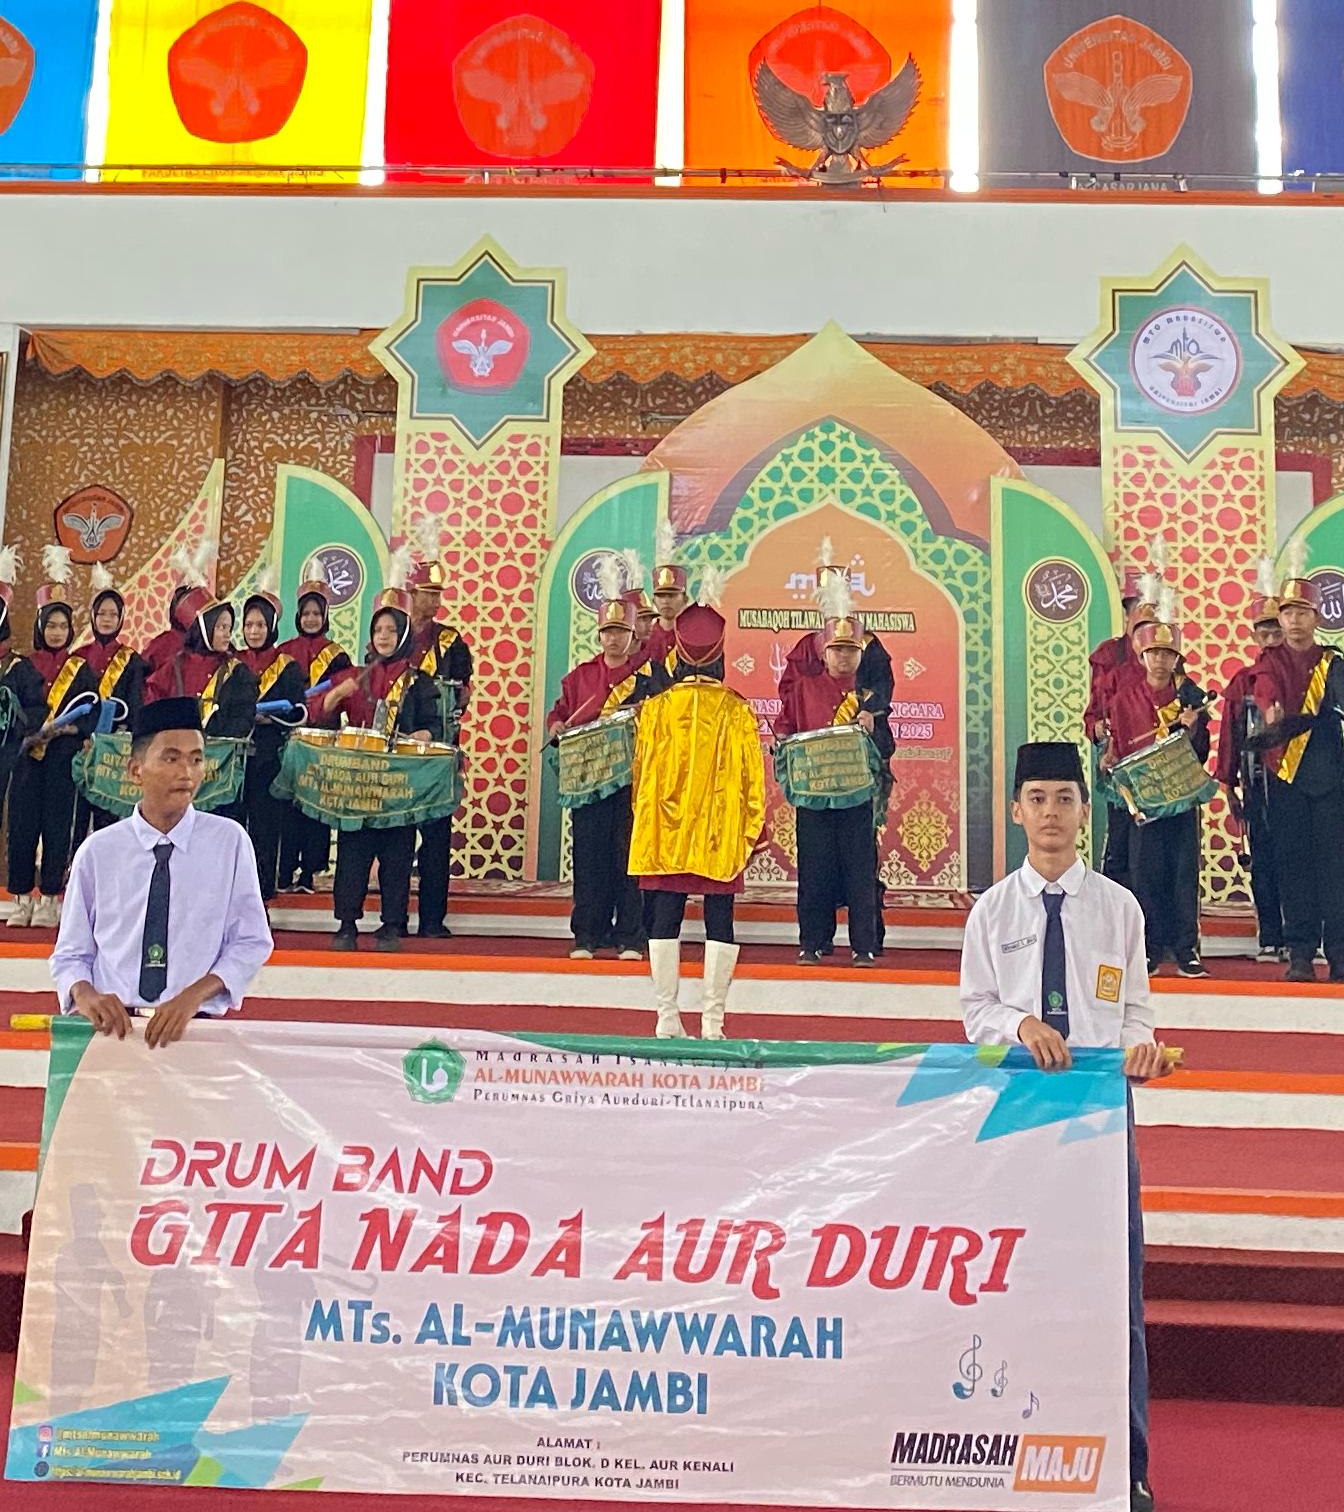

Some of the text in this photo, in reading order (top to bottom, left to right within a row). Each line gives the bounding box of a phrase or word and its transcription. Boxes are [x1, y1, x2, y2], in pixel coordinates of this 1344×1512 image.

[739, 610, 790, 631] MUSABAQOH
[866, 614, 915, 632] MAHASISWA
[900, 722, 932, 739] 2025
[319, 753, 391, 771] DRUMBAND
[473, 1067, 765, 1092] AL-MUNAWWARAH KOTA JAMBI
[139, 1139, 495, 1197] DRUM BAND
[130, 1198, 1029, 1306] GITA NADA AUR DURI
[304, 1299, 844, 1360] MTs. AL-MUNAWWARAH
[433, 1362, 709, 1415] KOTA JAMBI
[536, 1437, 593, 1449] ALAMAT
[402, 1451, 479, 1465] PERUMNAS
[483, 1453, 513, 1466] AUR
[516, 1455, 550, 1467] DURI
[600, 1458, 610, 1469] D
[614, 1458, 646, 1471] KEL.
[649, 1460, 679, 1472] AUR
[682, 1461, 735, 1473] KENALI
[891, 1432, 1099, 1482] MADRASAH MAJU
[456, 1472, 680, 1490] KEC. TELANAIPURA KOTA JAMBI
[890, 1474, 1005, 1489] BERMUTU MENDUNIA
